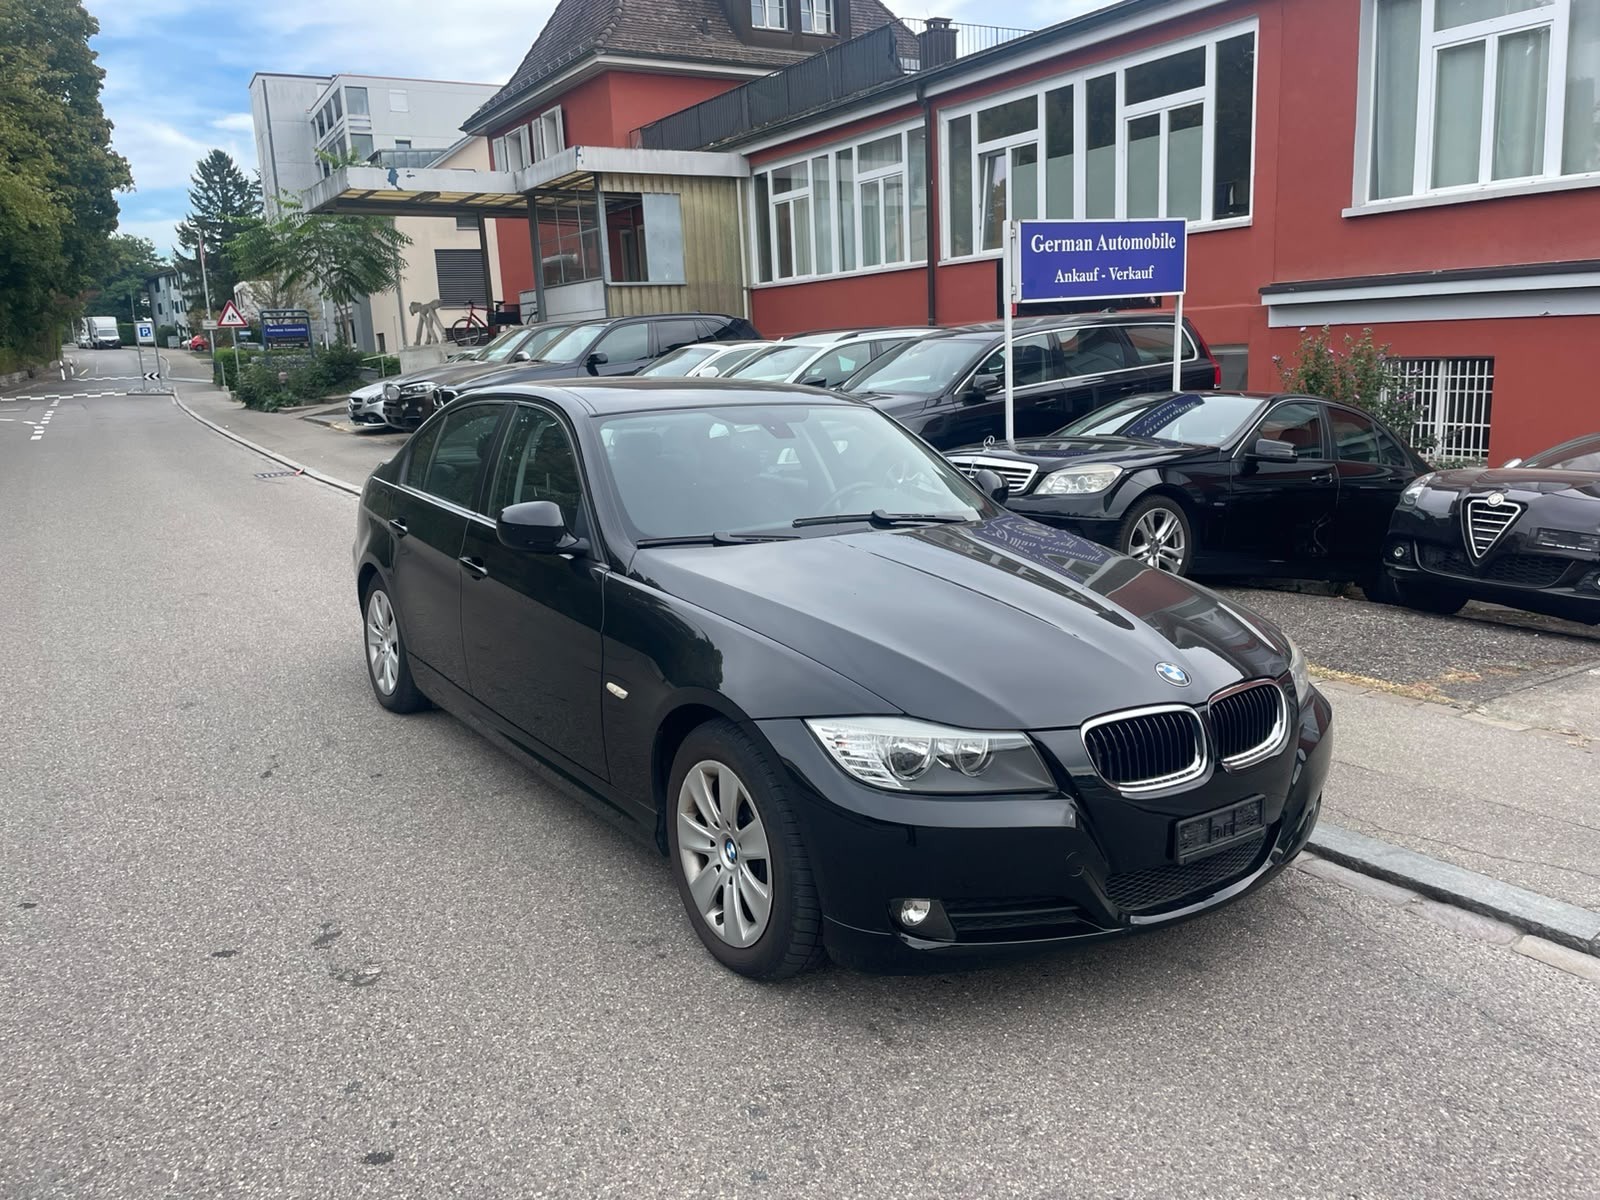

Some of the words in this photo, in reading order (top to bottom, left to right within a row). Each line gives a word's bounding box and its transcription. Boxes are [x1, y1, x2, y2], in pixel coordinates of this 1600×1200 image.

[1031, 234, 1093, 253] German
[1096, 232, 1177, 251] Automobile
[1054, 267, 1100, 283] Ankauf
[1108, 265, 1155, 281] Verkauf
